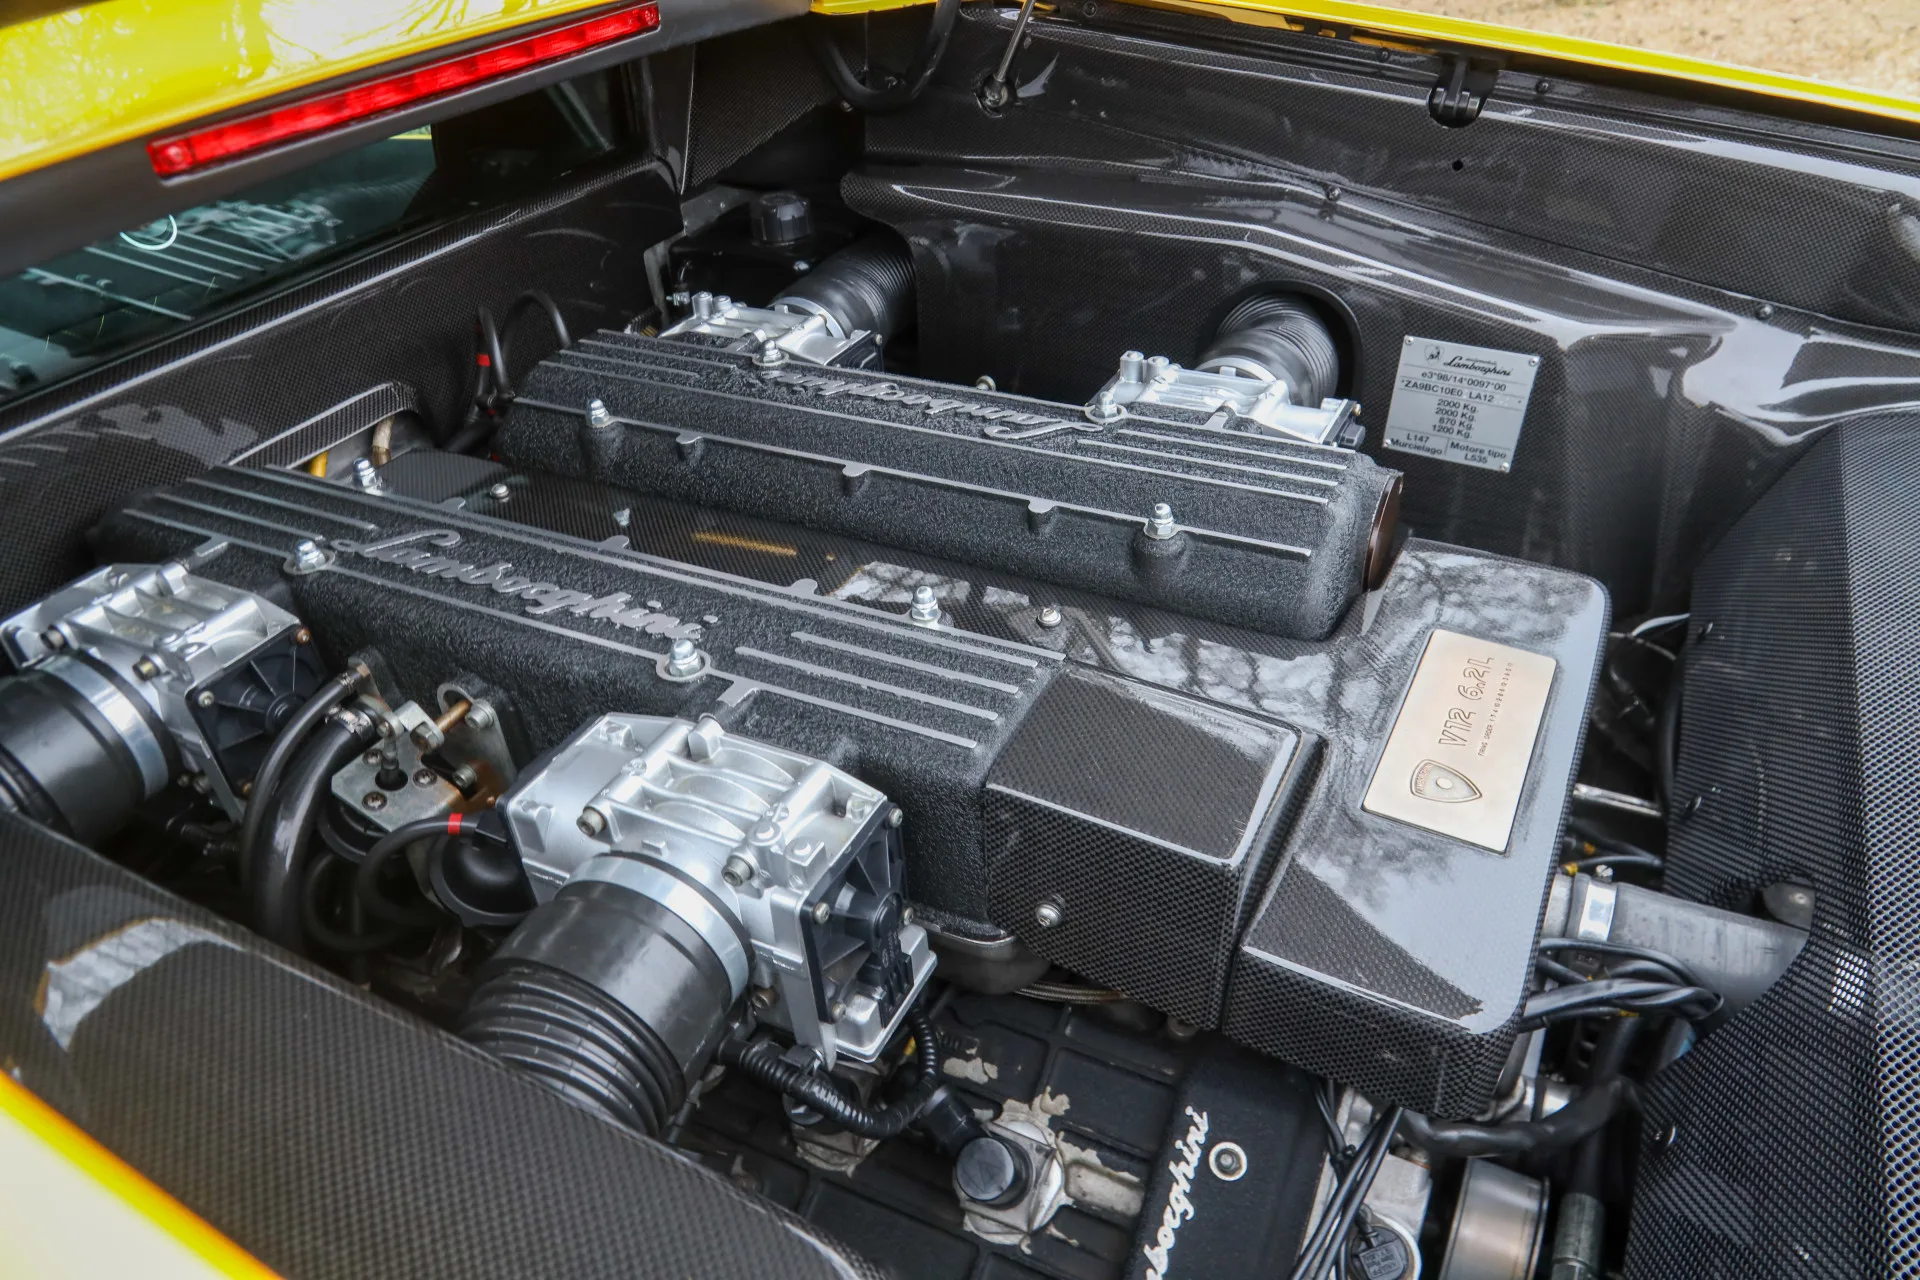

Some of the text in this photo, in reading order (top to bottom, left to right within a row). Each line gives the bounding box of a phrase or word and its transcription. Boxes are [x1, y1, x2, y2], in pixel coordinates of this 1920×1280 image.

[1443, 355, 1513, 377] Lamborghini
[1468, 391, 1495, 403] LA12
[752, 368, 1104, 440] Lamborghini
[1437, 398, 1461, 409] 2000
[1435, 406, 1459, 418] 2000
[1438, 416, 1457, 426] 870
[1431, 424, 1455, 435] 1200
[1406, 432, 1430, 443] L147
[1389, 437, 1443, 455] Murcielago
[1449, 441, 1507, 460] Motore tipo
[1463, 453, 1488, 464] L535
[330, 528, 718, 641] Lamborghini
[1438, 656, 1495, 747] V12 6.2L
